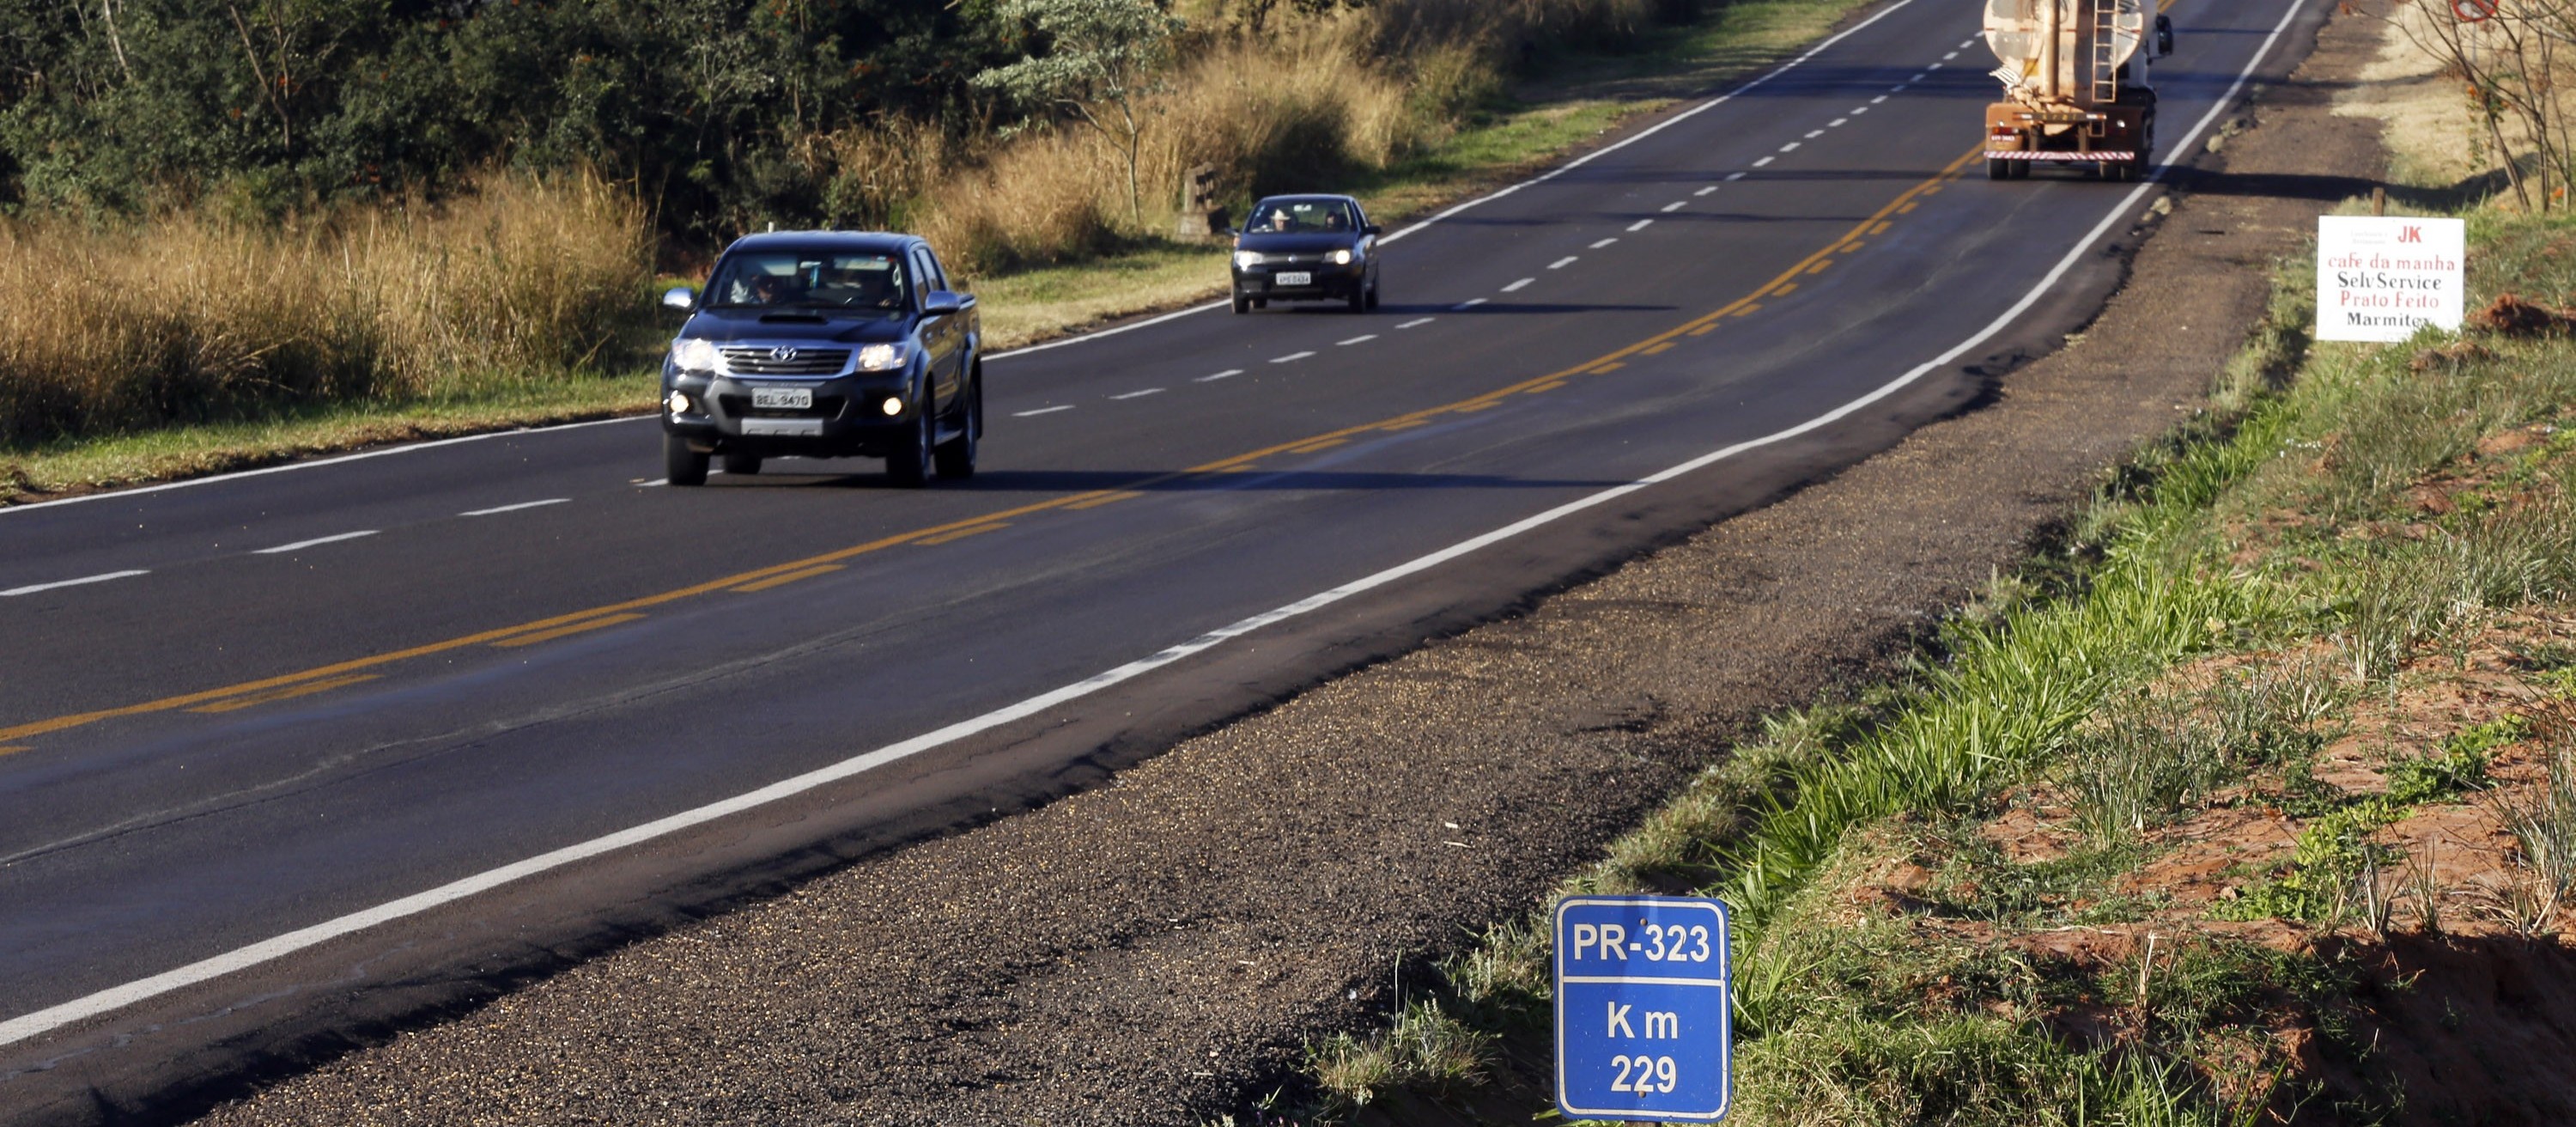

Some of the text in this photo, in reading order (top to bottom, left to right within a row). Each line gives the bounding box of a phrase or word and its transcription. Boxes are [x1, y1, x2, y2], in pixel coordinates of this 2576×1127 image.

[2397, 226, 2421, 243] JK
[2370, 253, 2390, 269] da
[2397, 254, 2455, 271] manha
[2341, 290, 2439, 308] Prato Feito
[1574, 923, 1710, 962] PR-323
[1611, 1055, 1676, 1093] 229
